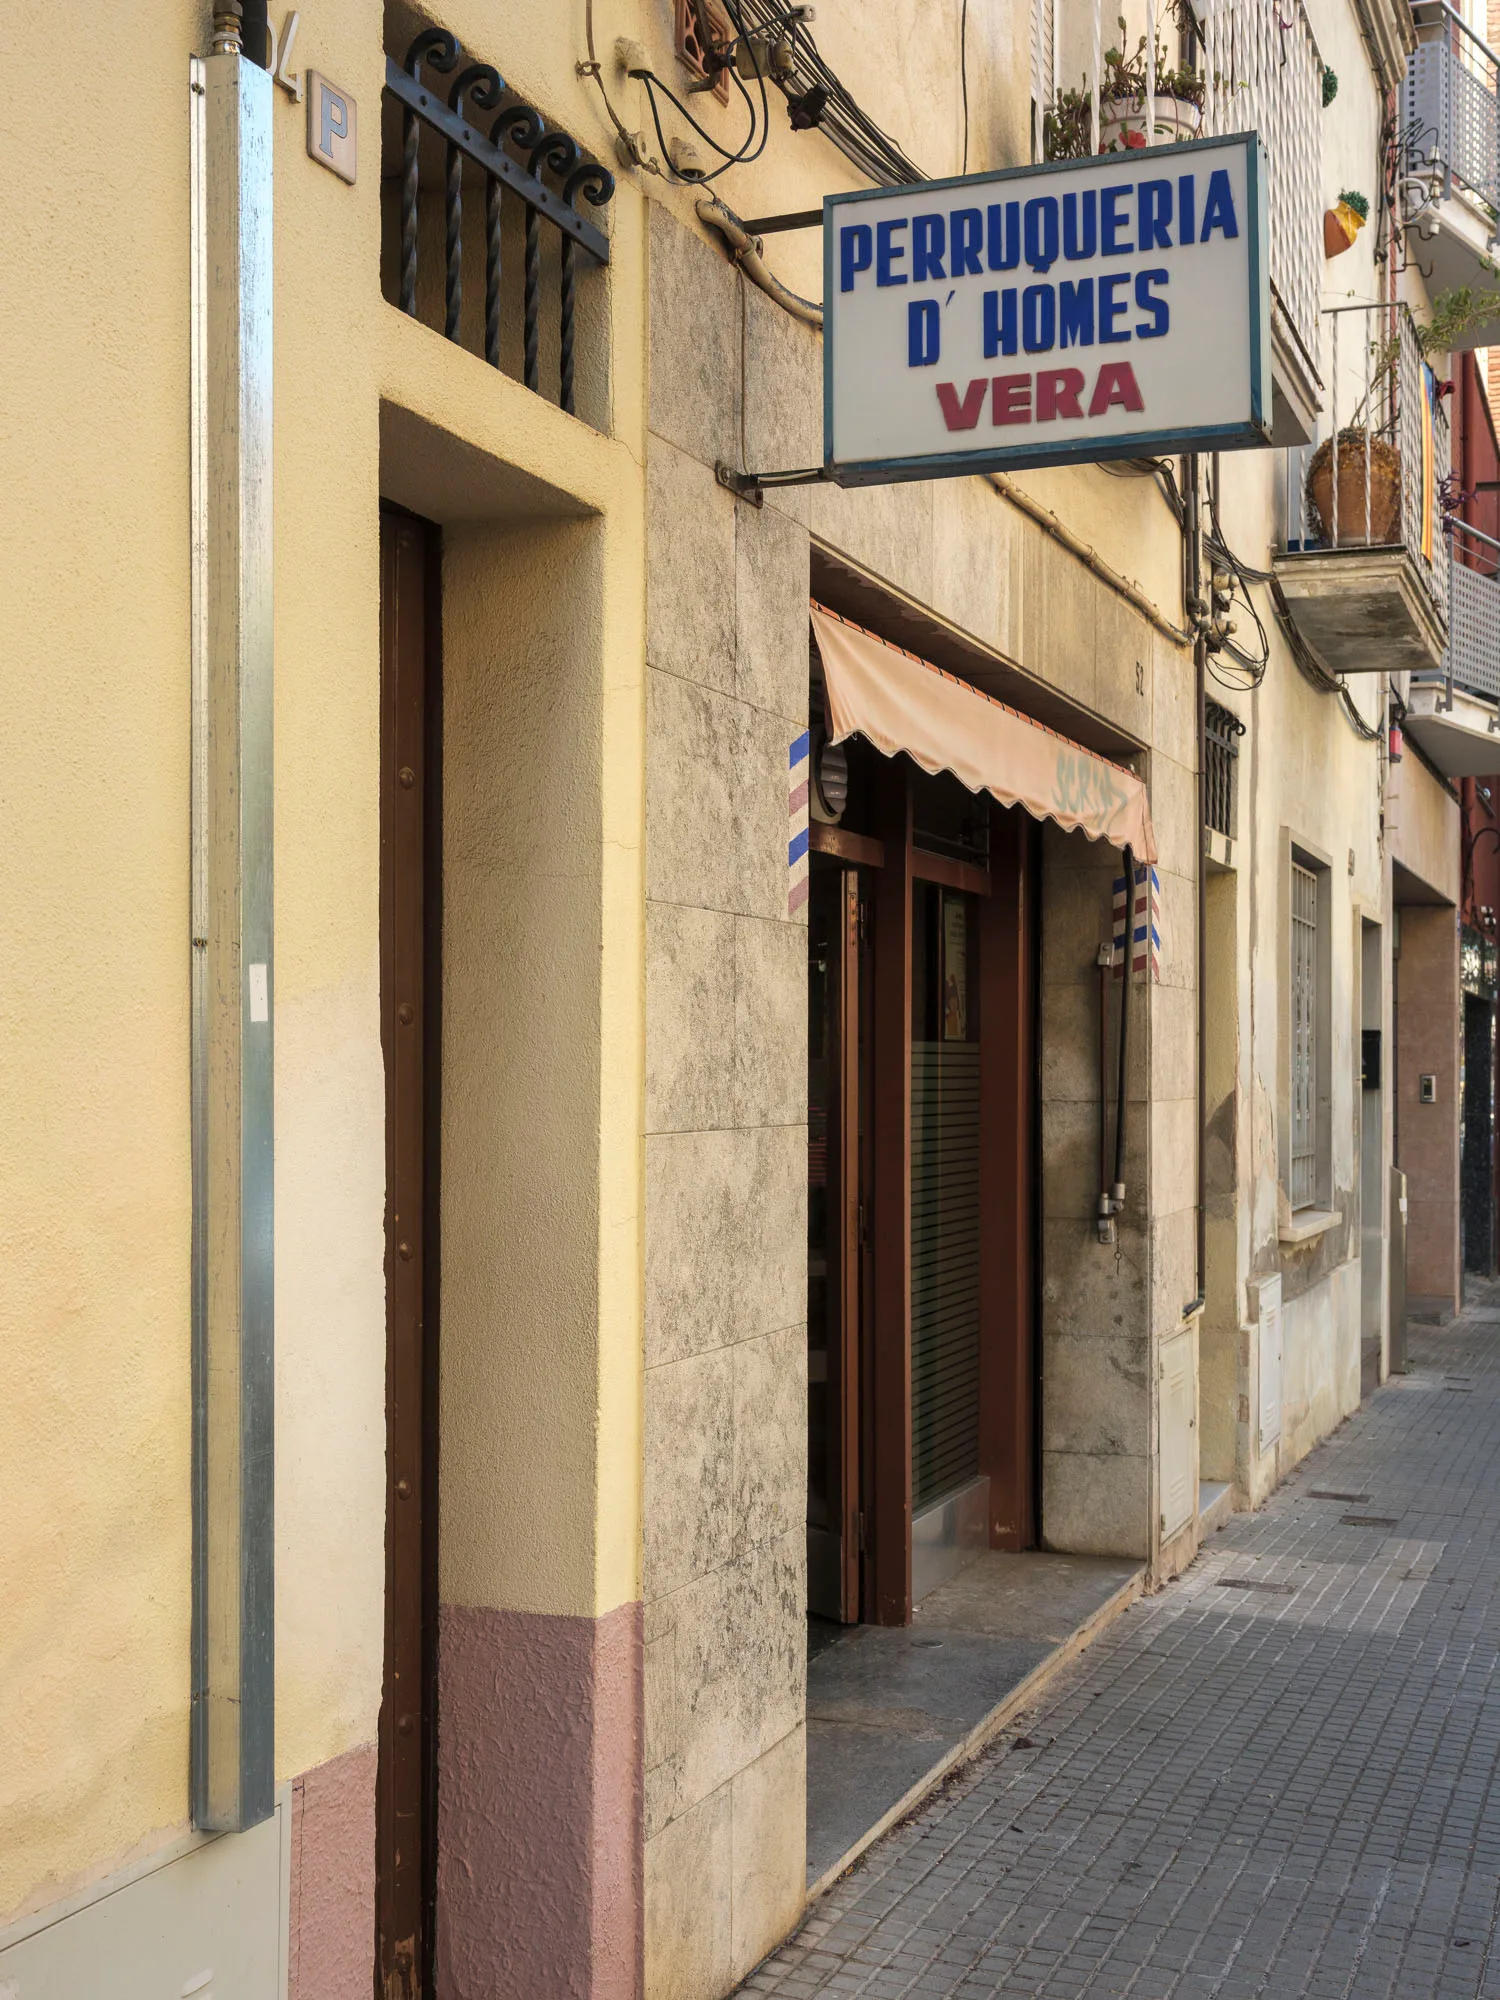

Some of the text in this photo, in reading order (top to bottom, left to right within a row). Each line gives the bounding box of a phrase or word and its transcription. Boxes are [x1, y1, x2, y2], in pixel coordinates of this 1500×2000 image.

[319, 83, 348, 159] P
[840, 169, 1239, 292] PERRUQUERIA
[983, 268, 1170, 358] HOMES
[935, 361, 1145, 431] VERA
